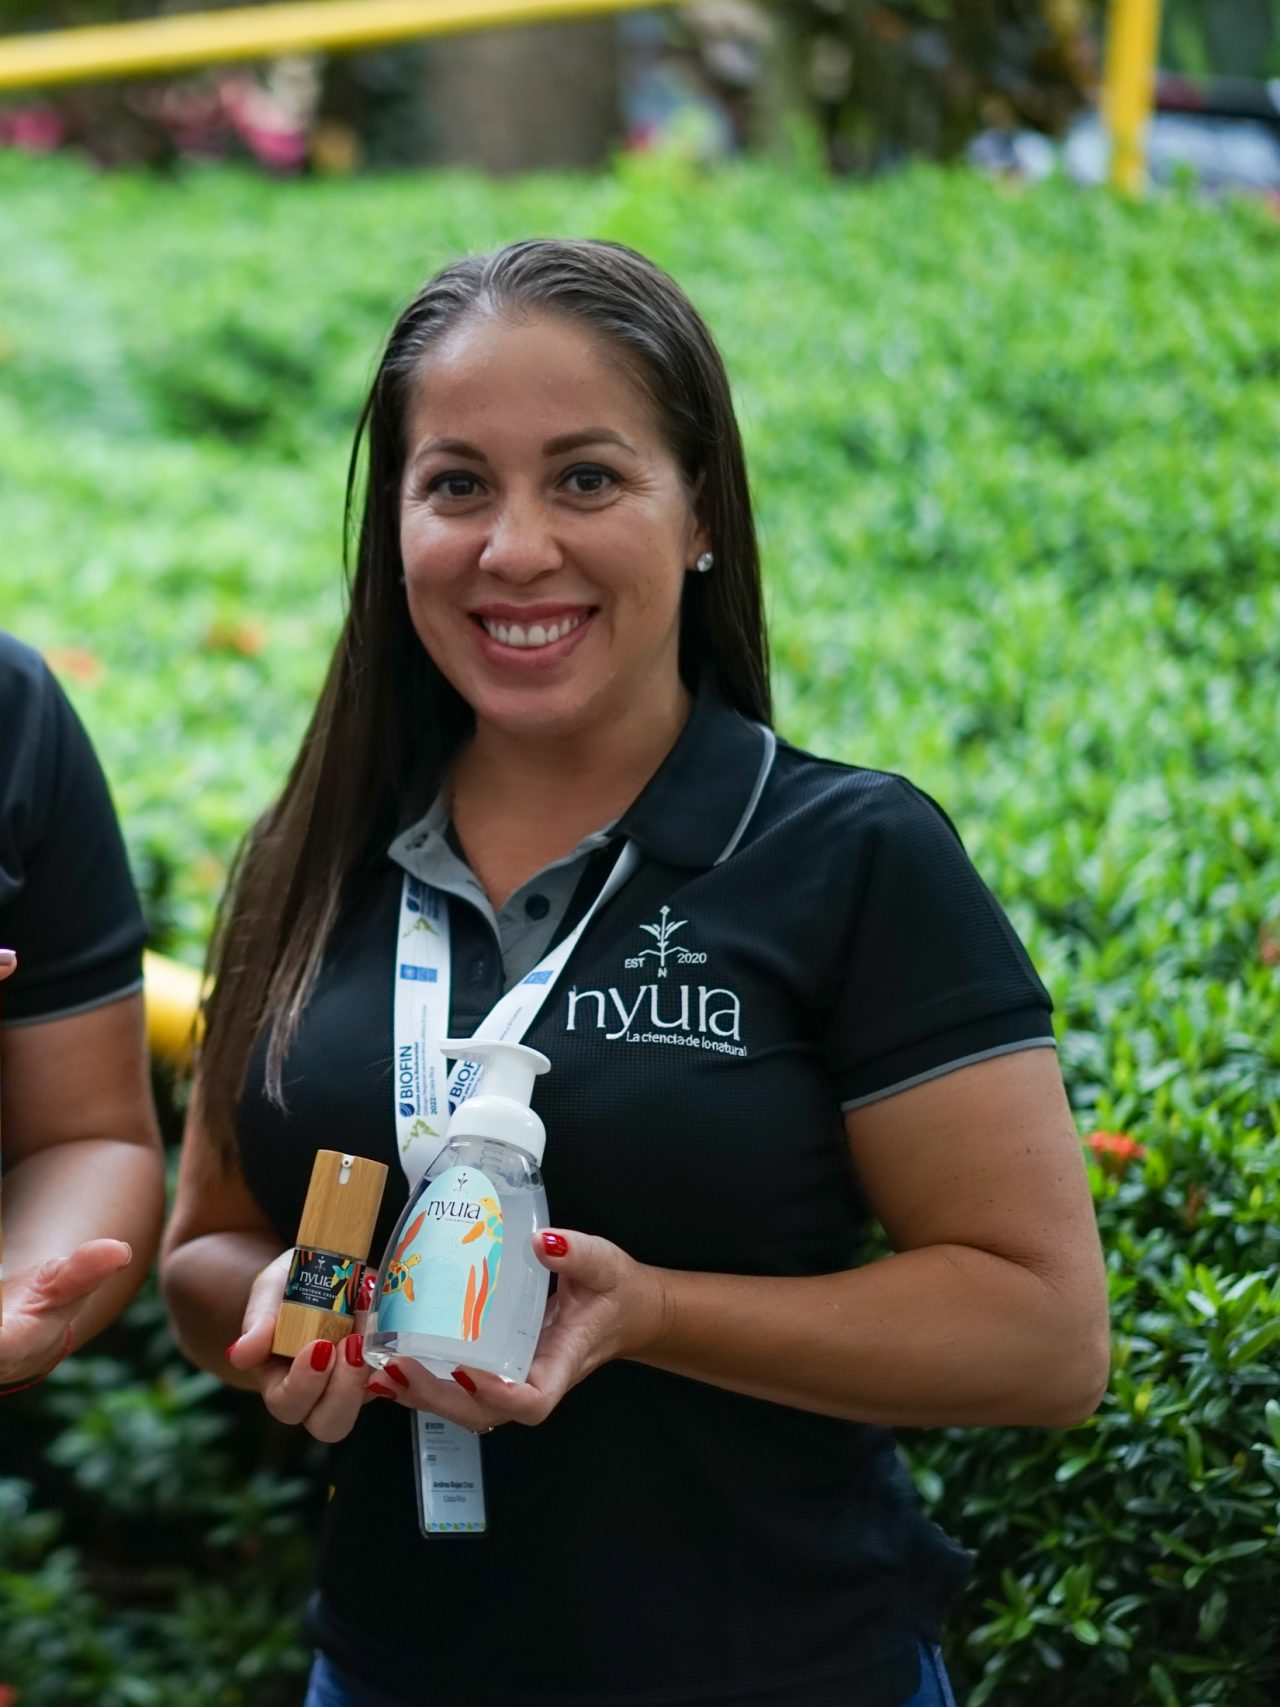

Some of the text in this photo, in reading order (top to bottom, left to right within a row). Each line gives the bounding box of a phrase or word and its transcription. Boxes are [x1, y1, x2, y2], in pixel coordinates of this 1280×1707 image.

[624, 952, 707, 969] EST 2020
[566, 984, 741, 1042] nyura
[626, 1030, 748, 1057] La ciencia de lo natural
[399, 1045, 413, 1099] BIOFIN
[450, 1060, 474, 1098] BIOF
[427, 1200, 481, 1221] nyura
[299, 1271, 334, 1289] nyura
